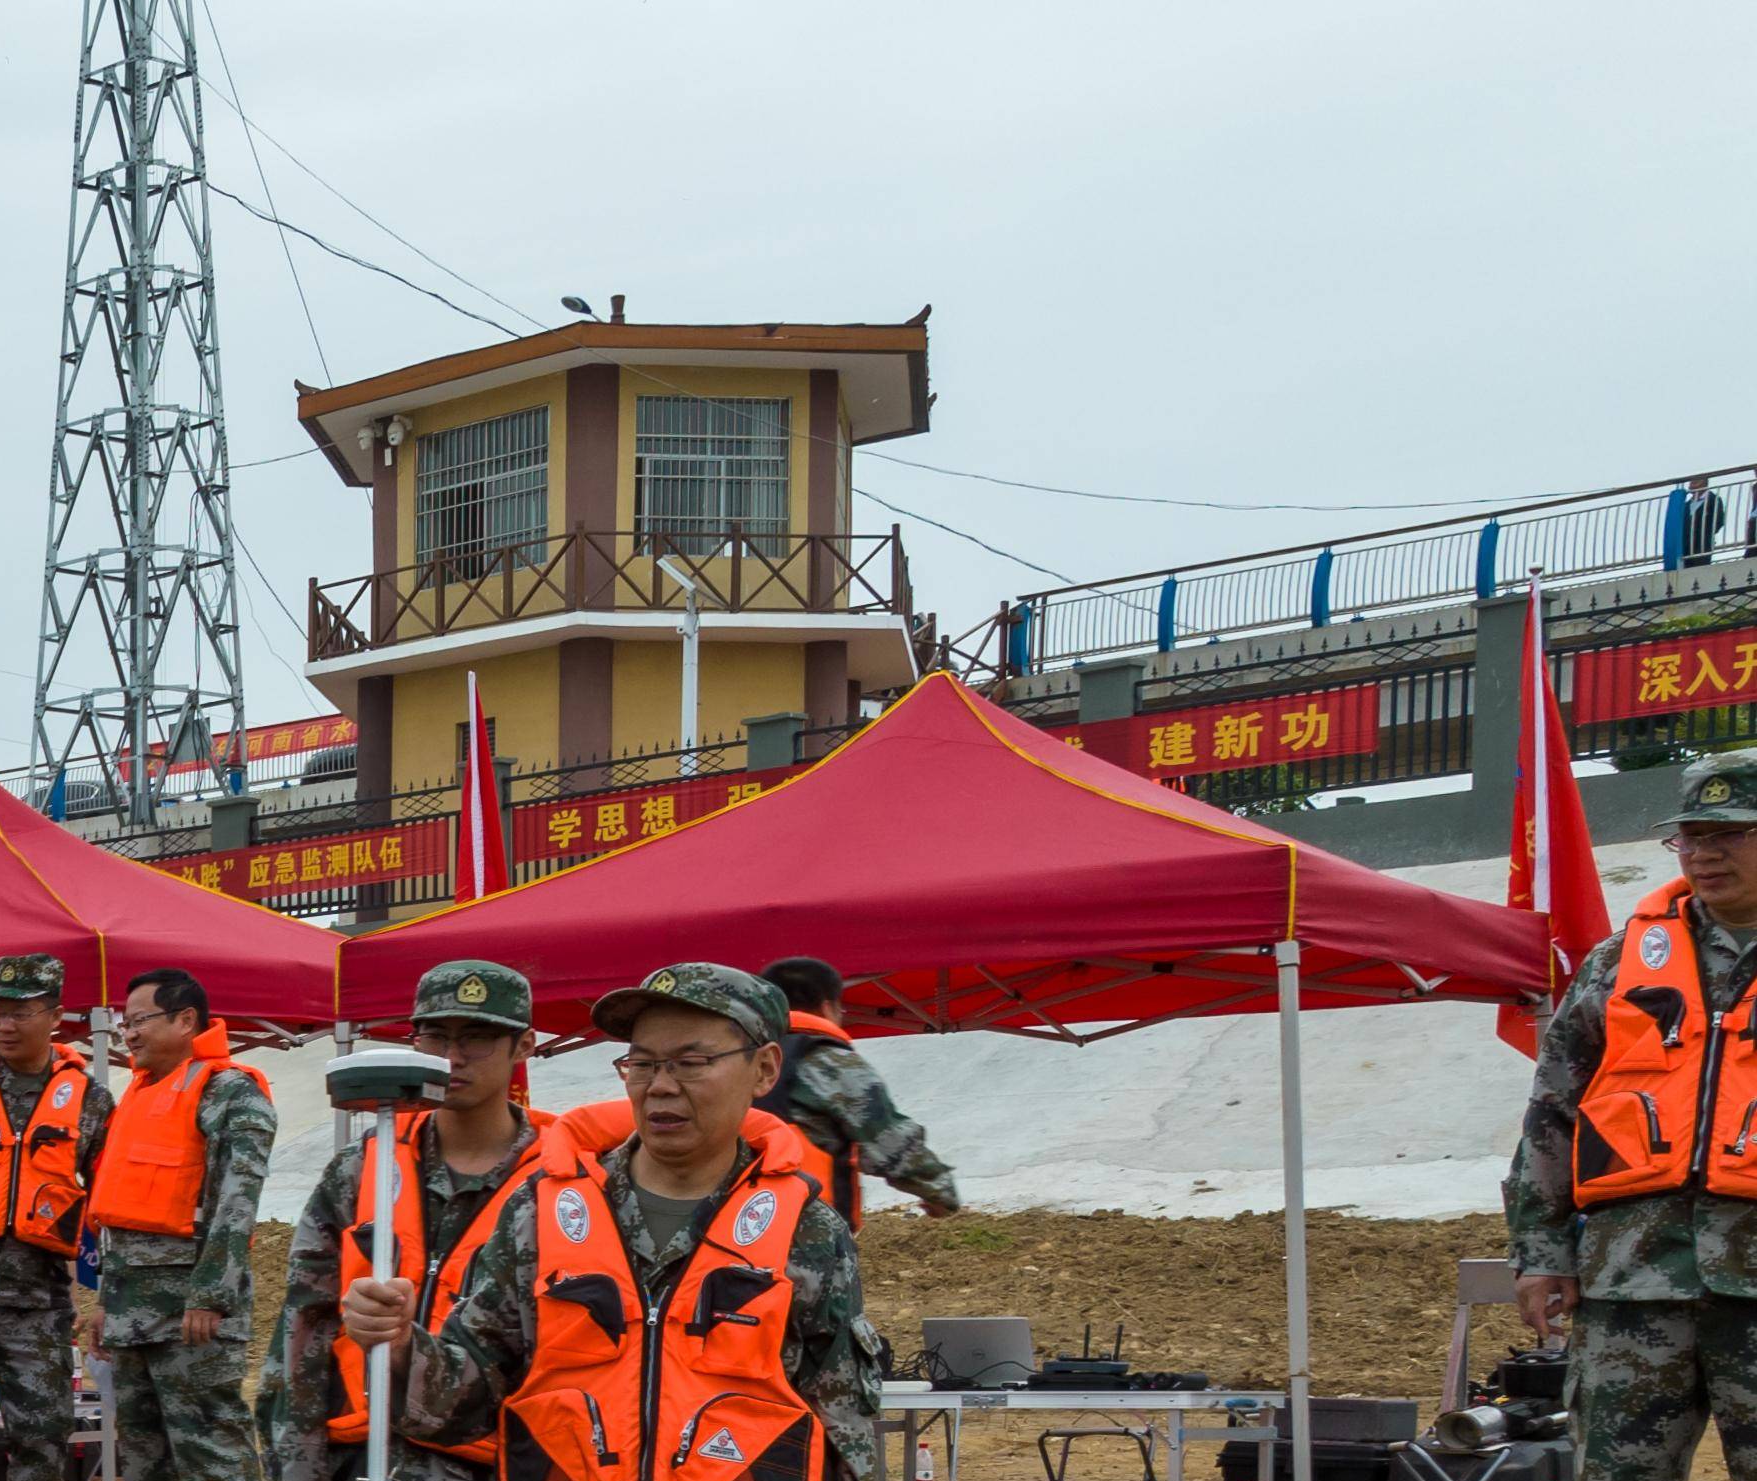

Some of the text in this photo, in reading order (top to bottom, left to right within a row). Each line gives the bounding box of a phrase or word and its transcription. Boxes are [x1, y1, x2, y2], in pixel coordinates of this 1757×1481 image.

[1148, 703, 1330, 769] 建新功
[547, 795, 677, 849] 学思想
